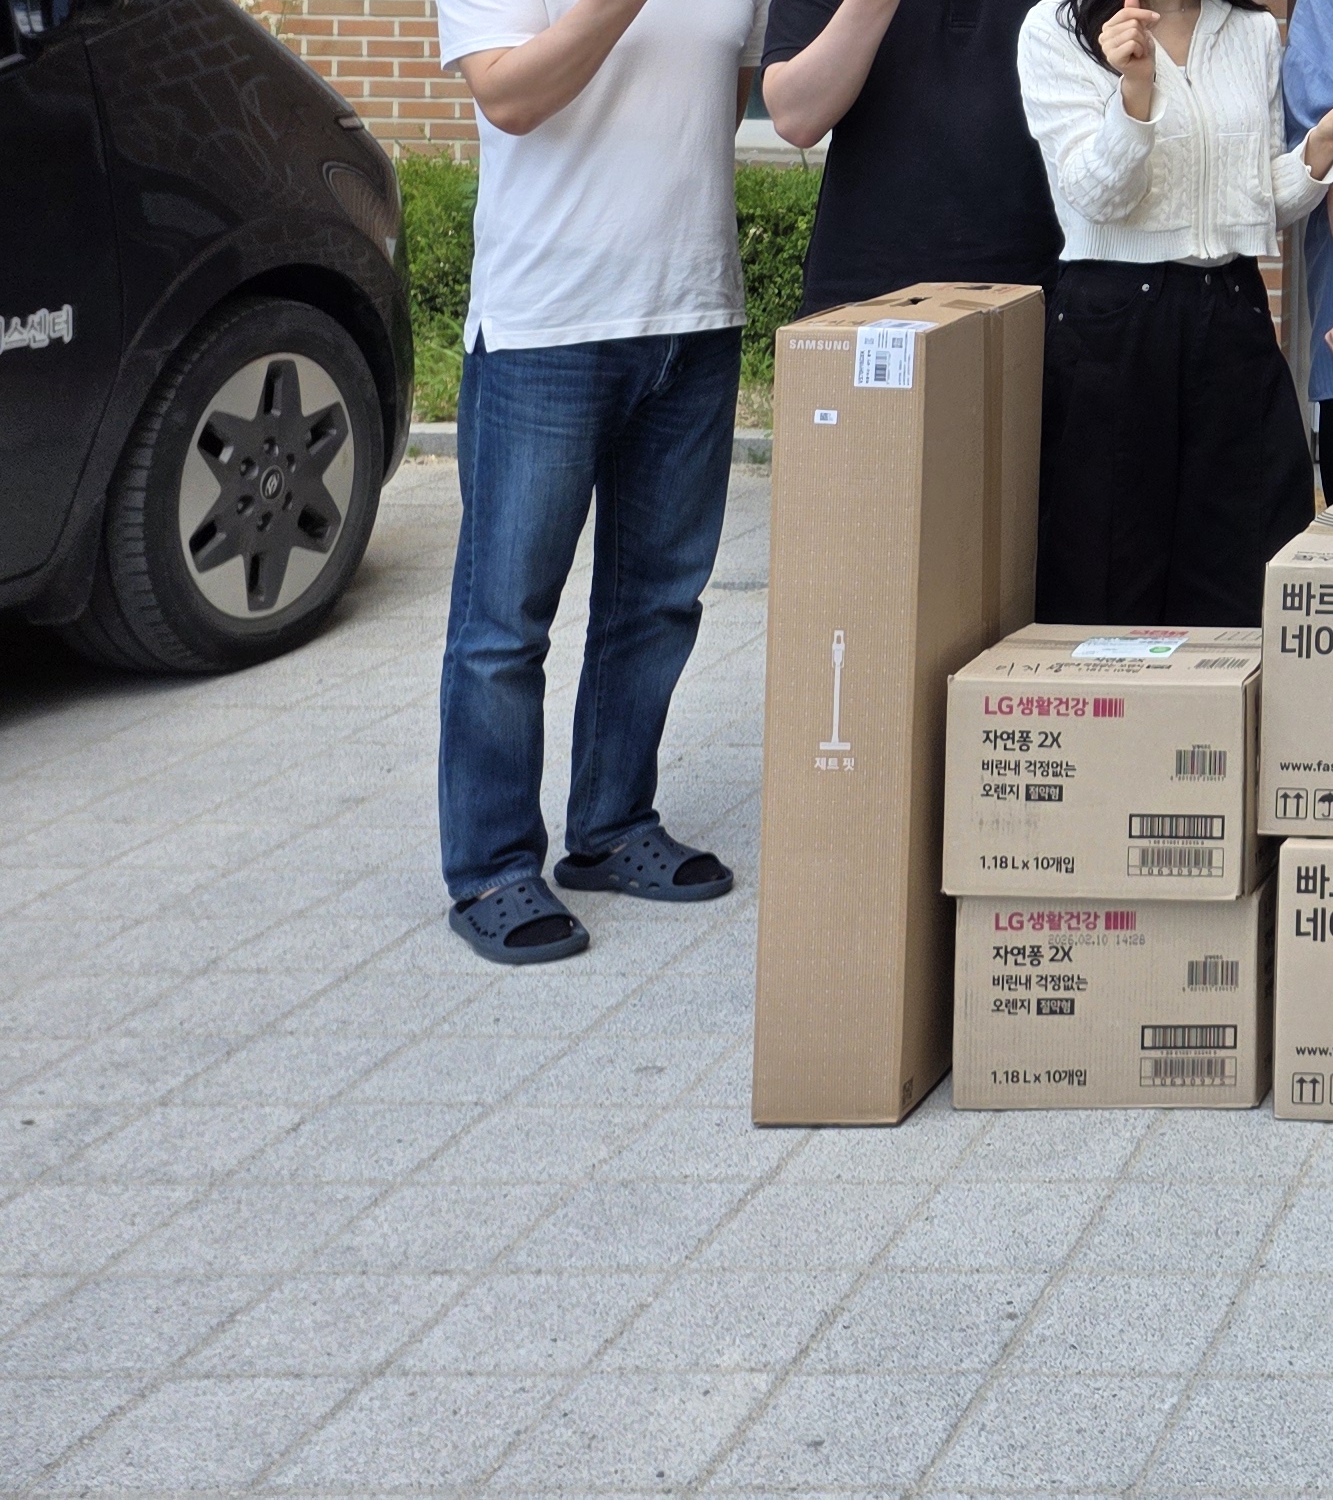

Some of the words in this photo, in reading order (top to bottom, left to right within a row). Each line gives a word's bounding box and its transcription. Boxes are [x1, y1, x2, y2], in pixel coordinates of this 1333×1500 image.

[789, 338, 851, 351] SAMSUNG
[982, 729, 1033, 752] 자연퐁
[1037, 731, 1063, 750] 2X
[814, 756, 840, 771] 제트
[842, 756, 855, 772] 핏
[981, 759, 1021, 778] 비린내
[1024, 759, 1077, 779] 걱정없는
[980, 784, 1020, 802] 오렌지
[1033, 855, 1076, 874] 10개입
[992, 945, 1044, 967] 자연퐁
[1048, 946, 1074, 964] 2X
[992, 973, 1032, 991] 비린내
[1035, 973, 1089, 992] 걱정없는
[991, 998, 1031, 1015] 오렌지
[1045, 1068, 1088, 1087] 10개입
